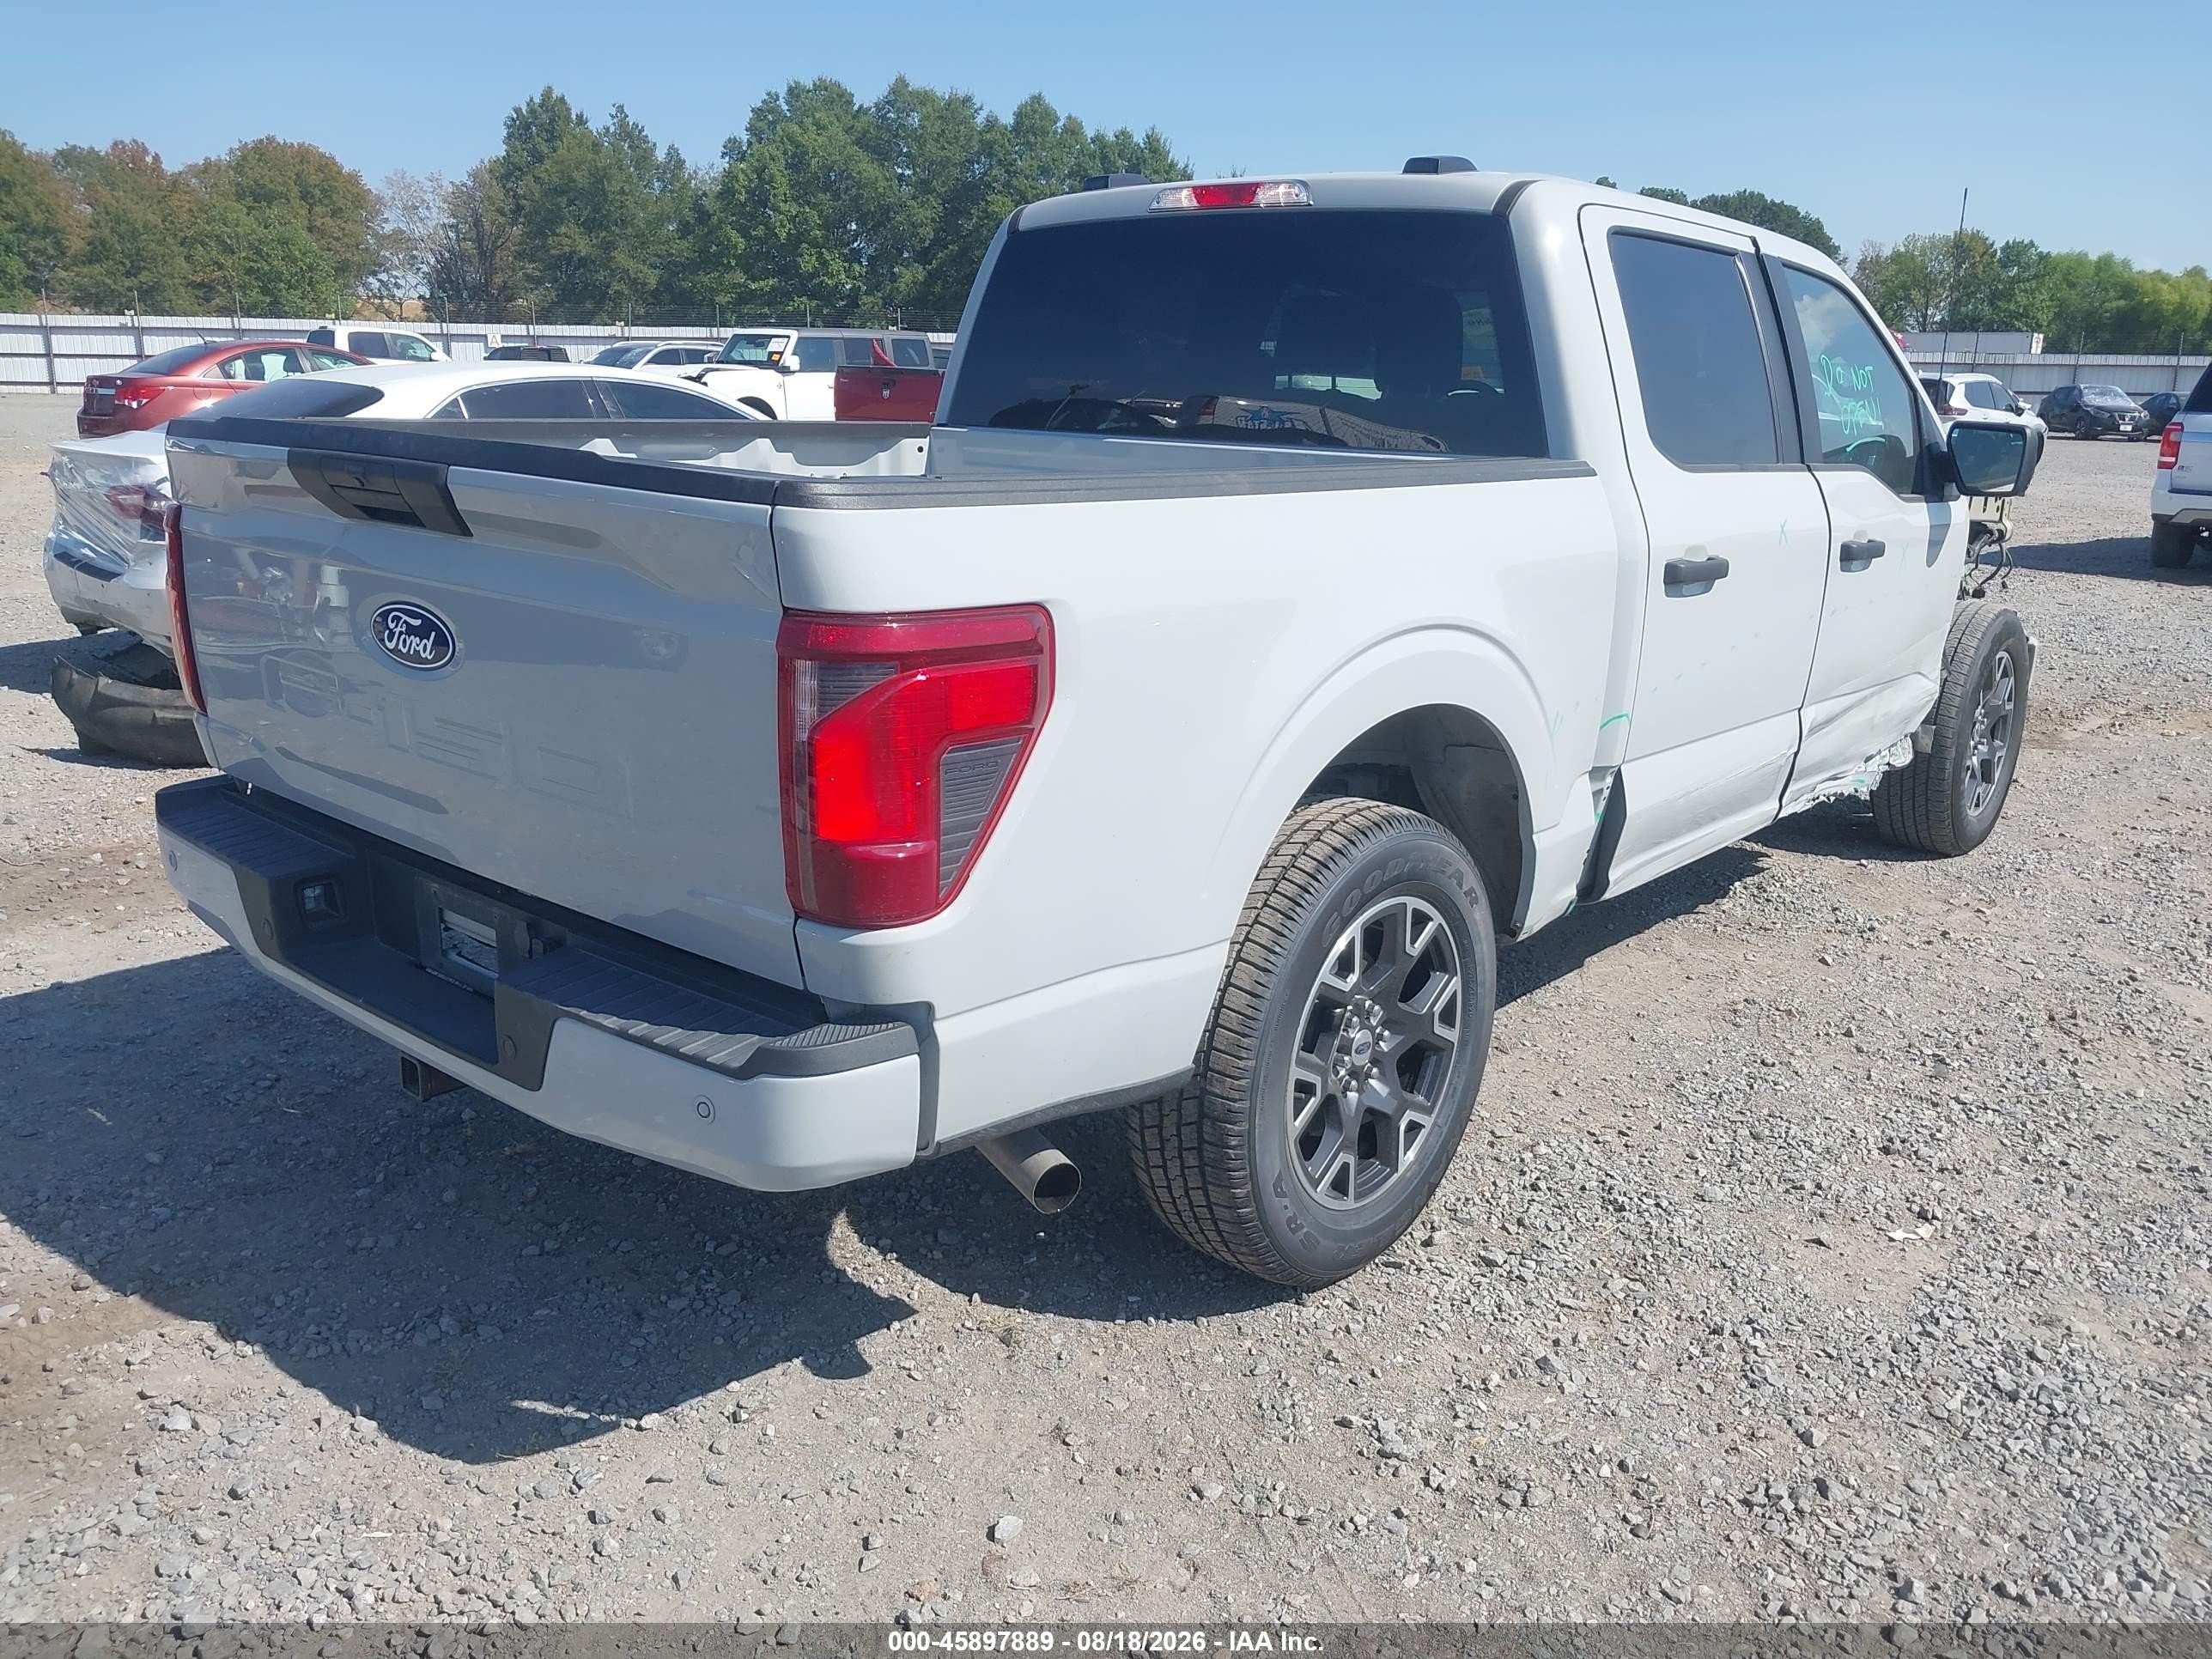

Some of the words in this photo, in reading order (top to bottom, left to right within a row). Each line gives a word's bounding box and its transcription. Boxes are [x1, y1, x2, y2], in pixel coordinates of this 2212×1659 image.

[490, 335, 500, 346] A
[1850, 364, 1875, 393] NOT
[384, 611, 436, 659] Ford
[945, 761, 999, 776] FORD
